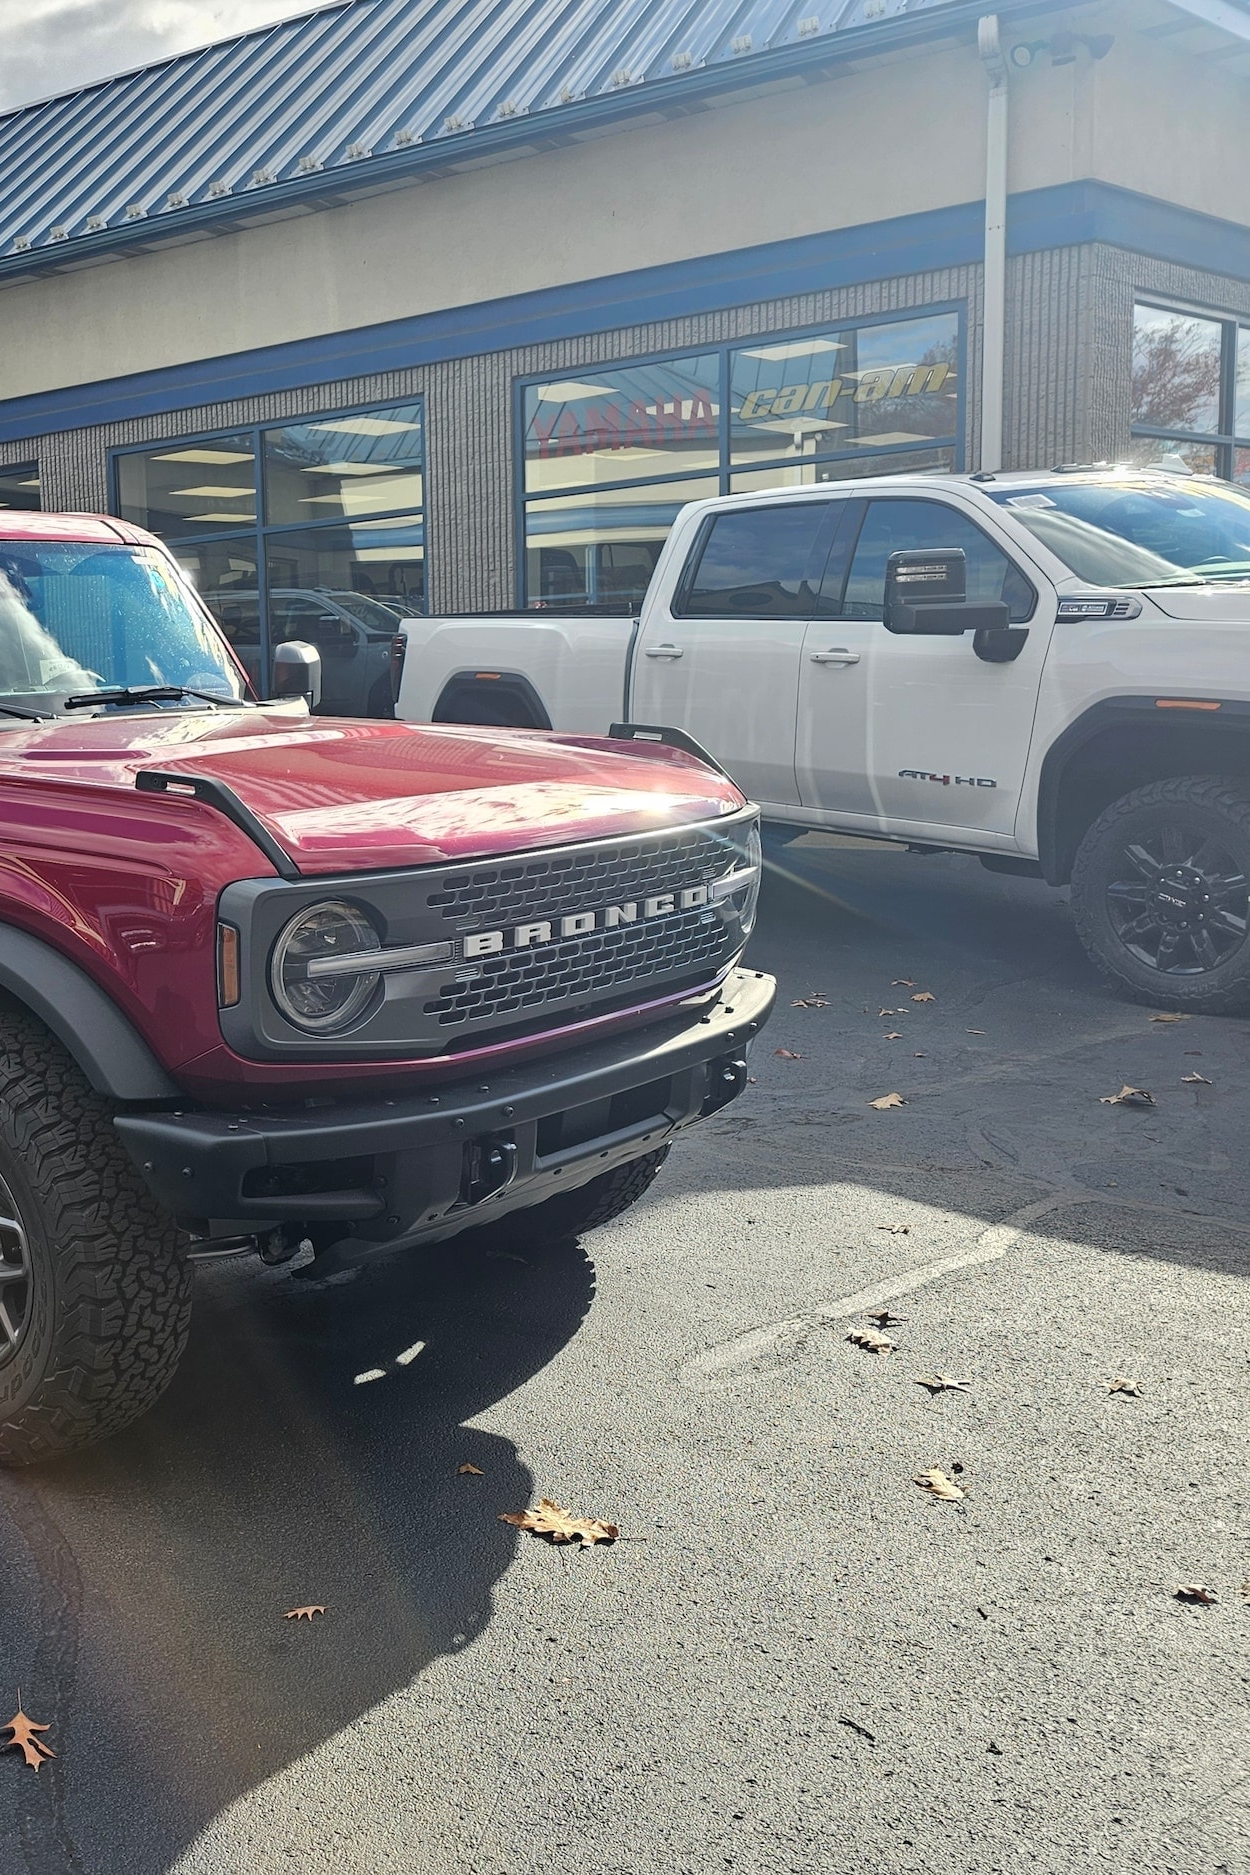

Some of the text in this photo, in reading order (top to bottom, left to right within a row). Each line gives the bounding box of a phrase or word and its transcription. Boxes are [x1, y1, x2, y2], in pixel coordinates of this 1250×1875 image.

[738, 362, 949, 420] can-am
[532, 389, 716, 459] YAMAHA
[898, 769, 997, 788] AT4 HD
[464, 885, 708, 957] BRONCO
